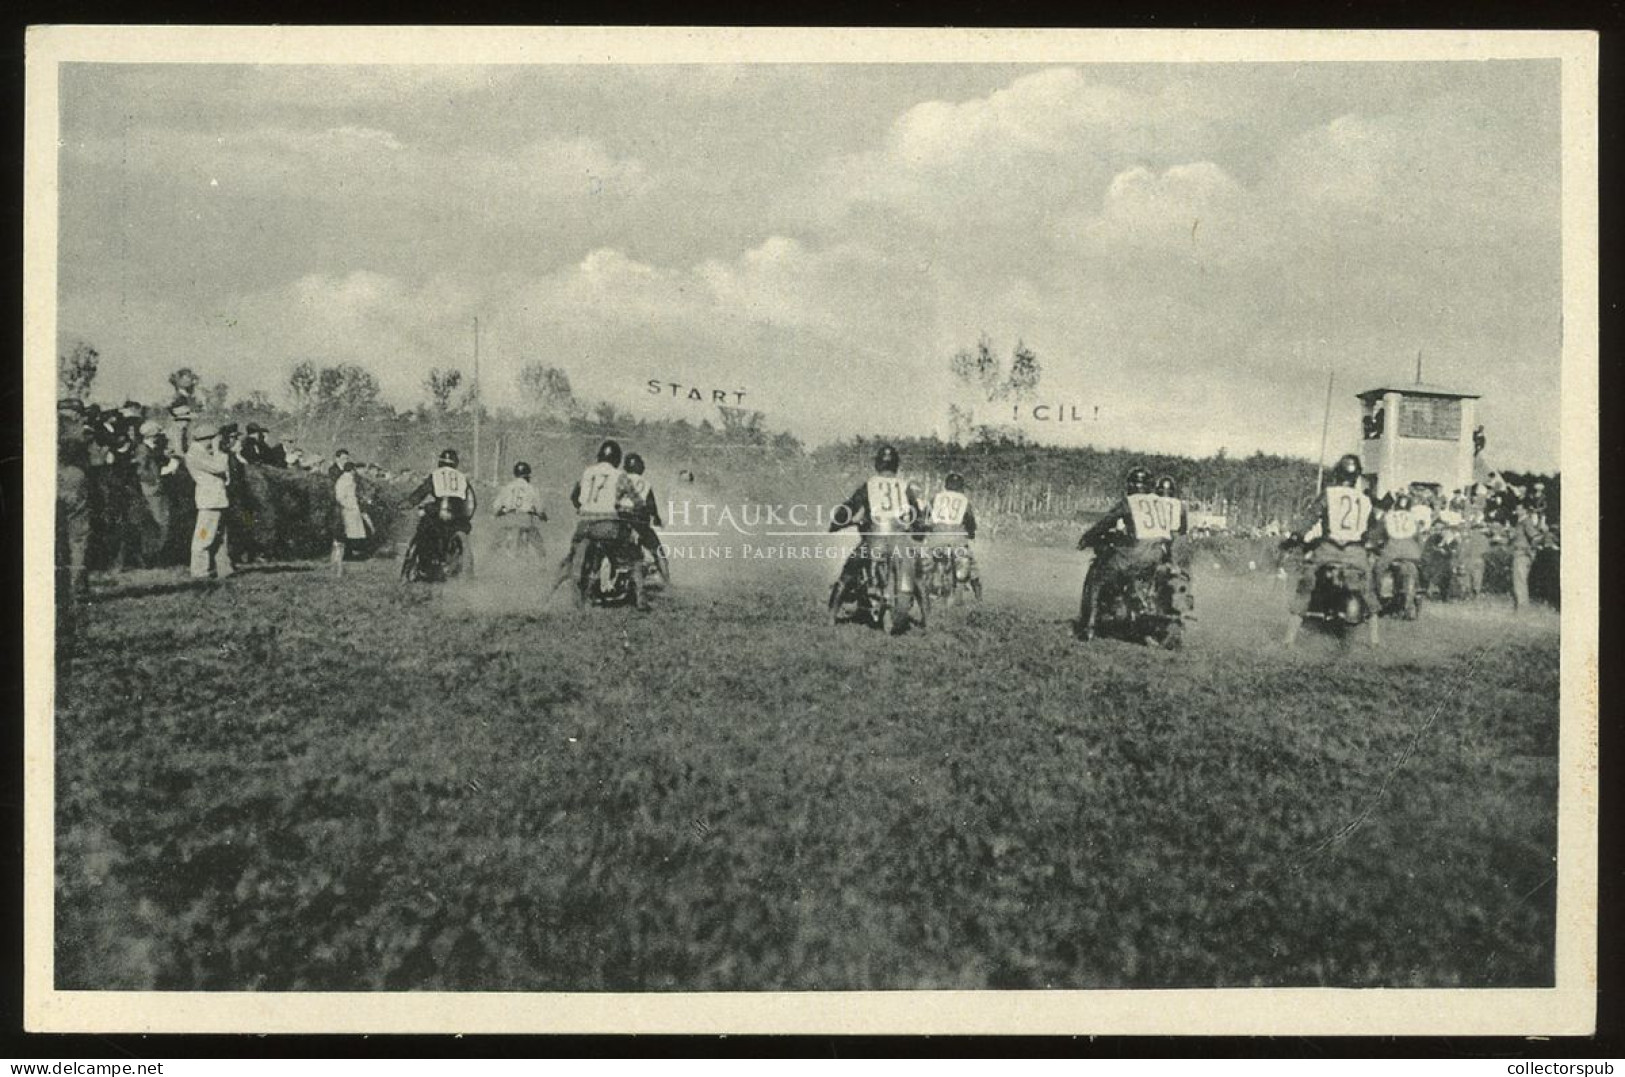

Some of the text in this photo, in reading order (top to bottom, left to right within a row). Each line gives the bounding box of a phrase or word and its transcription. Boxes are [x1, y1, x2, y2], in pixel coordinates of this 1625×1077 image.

[647, 379, 747, 404] START
[588, 474, 609, 503] 17
[878, 482, 903, 511] 31
[1340, 495, 1361, 531] 21
